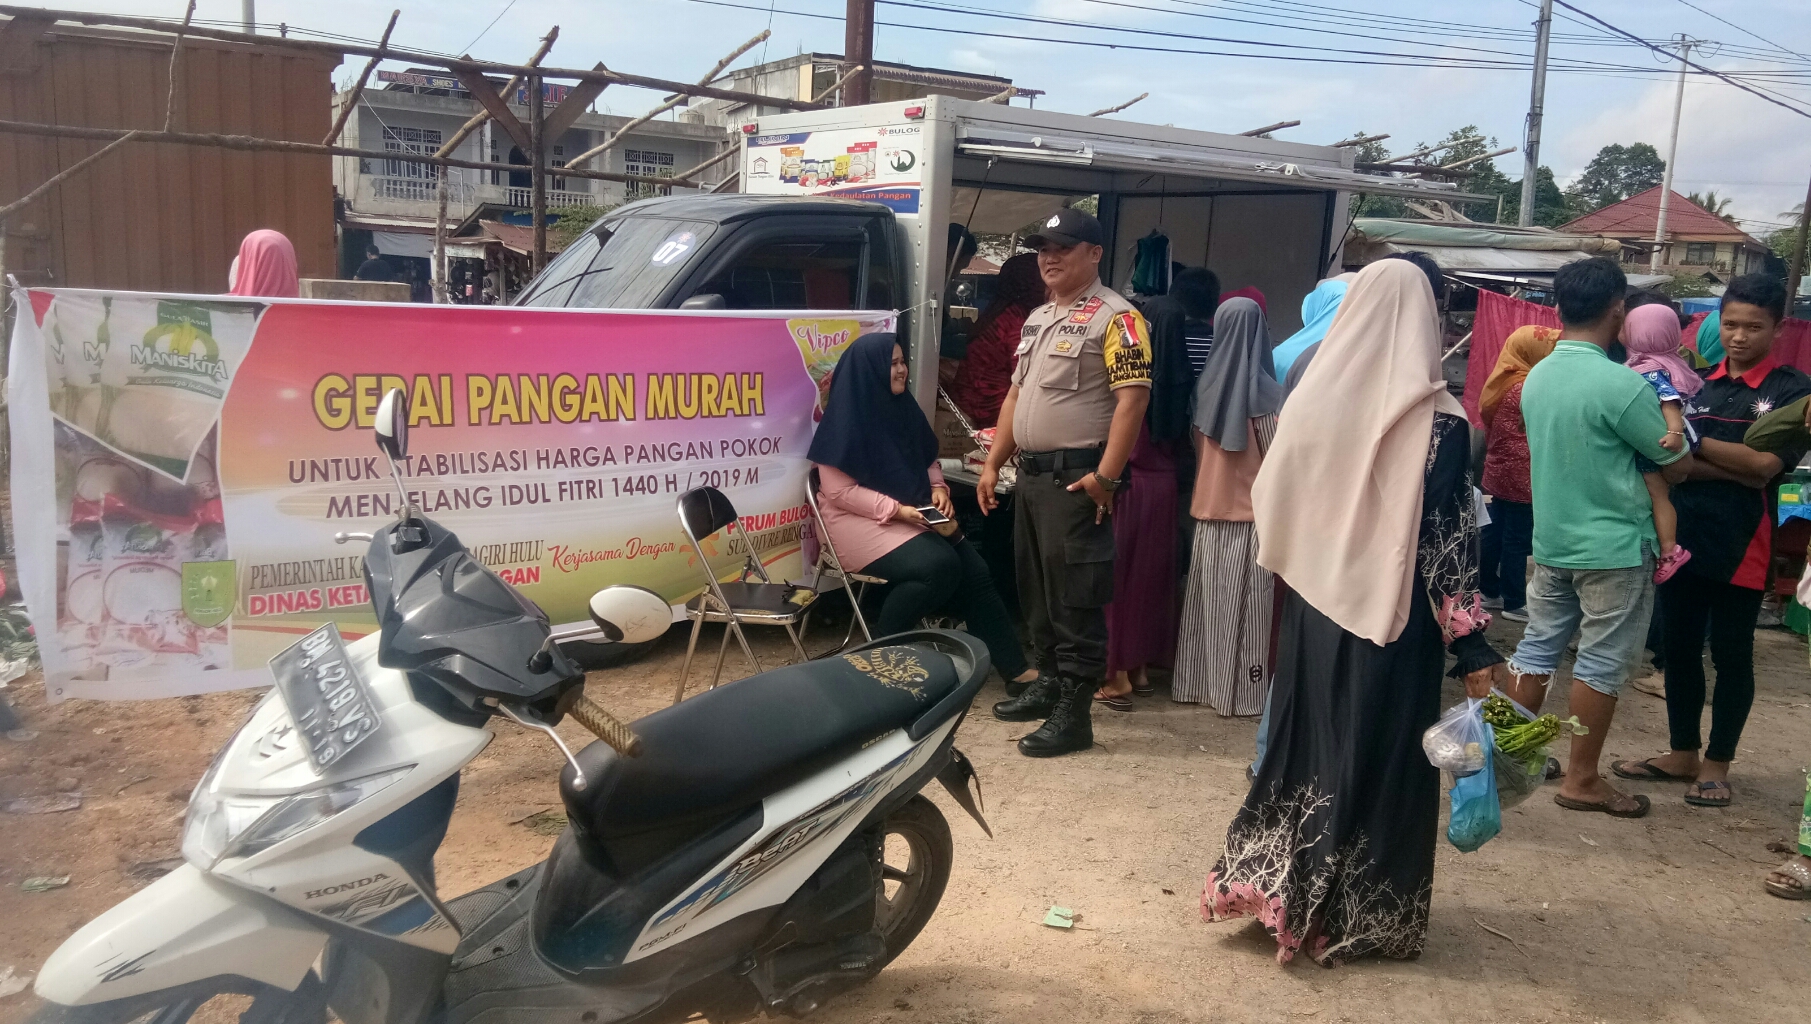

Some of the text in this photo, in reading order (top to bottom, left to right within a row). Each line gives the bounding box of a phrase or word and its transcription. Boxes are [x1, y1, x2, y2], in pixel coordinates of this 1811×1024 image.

[432, 79, 454, 88] SHOES
[889, 127, 920, 135] BULOG
[878, 192, 911, 200] Pangan
[652, 241, 689, 264] 07
[796, 324, 850, 354] Vipco
[1058, 325, 1088, 336] POLRI
[312, 372, 766, 431] GEAI PANGAN MURAH
[288, 456, 381, 484] UNTUK
[536, 446, 617, 470] HARGA
[624, 440, 714, 465] PANGAN
[720, 436, 782, 458] POKOK
[326, 466, 759, 519] MENELANG IDUL FITRI 1440 H / 2019 M
[780, 521, 818, 545] RENGA
[466, 540, 544, 566] AGIRI HULU
[547, 537, 676, 573] Kerjasama Dengan
[249, 556, 345, 590] PEMERINTAH
[493, 565, 540, 586] GAN
[249, 588, 323, 617] DINAS
[301, 629, 372, 743] BM 4219 VS
[303, 873, 391, 900] HONDA
